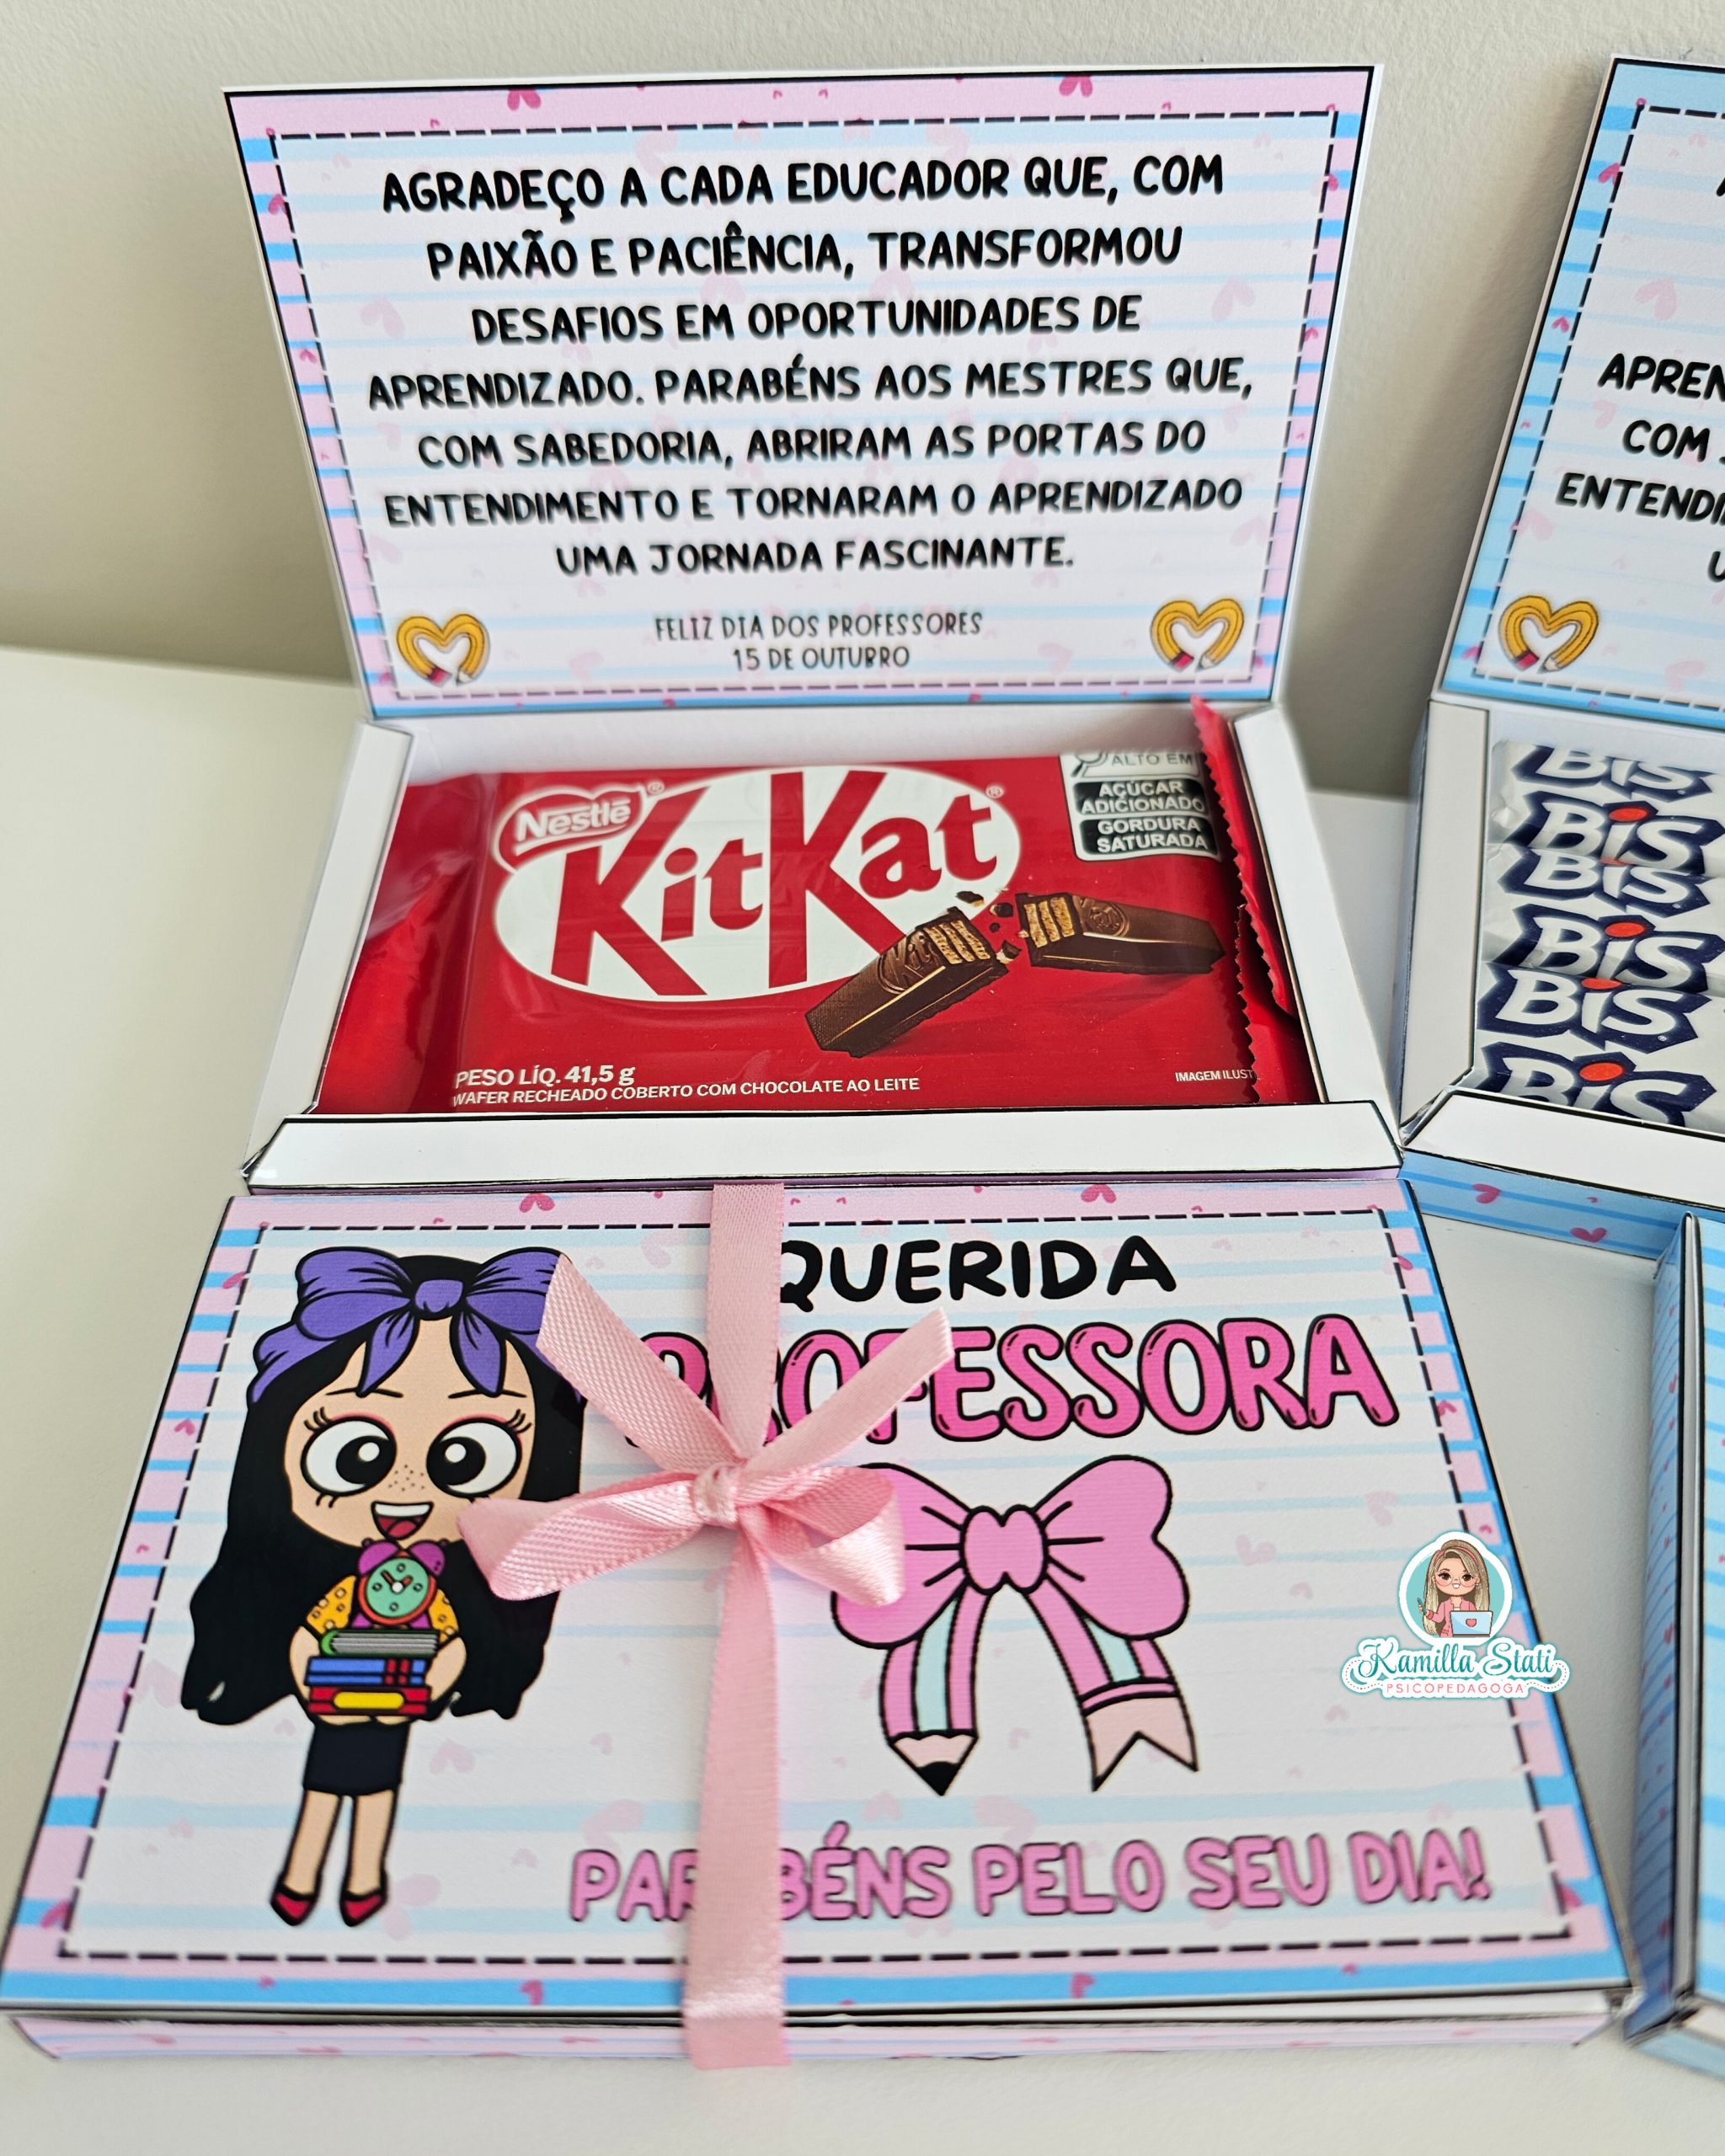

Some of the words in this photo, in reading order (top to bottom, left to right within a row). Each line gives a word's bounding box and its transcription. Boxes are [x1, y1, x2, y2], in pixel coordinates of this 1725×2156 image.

[382, 168, 605, 225] AGRADEÇO
[620, 167, 648, 208] A
[660, 163, 774, 206] CADA
[788, 158, 1010, 204] EDUCADOR
[1023, 156, 1119, 205] QUE,
[1133, 153, 1224, 196] COM
[426, 228, 579, 281] PAIXÃO
[590, 237, 617, 277] E
[628, 220, 854, 280] PACIÊNCIA,
[867, 225, 1183, 271] TRANSFORMOU
[471, 305, 664, 345] DESAFIOS
[676, 303, 735, 341] EM
[747, 296, 1080, 339] OPORTUNIDADES
[1092, 294, 1143, 332] DE
[369, 370, 644, 410] APRENDIZADO.
[654, 352, 861, 403] PARABÉNS
[874, 363, 952, 399] AOS
[965, 359, 1153, 398] MESTRES
[1166, 356, 1252, 400] QUE,
[418, 434, 504, 468] COM
[513, 430, 734, 469] SABEDORIA,
[746, 425, 912, 462] ABRIRAM
[925, 424, 975, 458] AS
[987, 420, 1145, 457] PORTAS
[1156, 419, 1206, 454] DO
[1622, 419, 1711, 463] COM
[383, 489, 680, 526] ENTENDIMENTO
[692, 488, 714, 520] E
[726, 483, 938, 519] TORNARAM
[951, 483, 975, 514] O
[988, 478, 1242, 514] APRENDIZADO
[1556, 472, 1725, 526] ENTENDI
[555, 545, 638, 576] UMA
[649, 541, 823, 574] JORNADA
[836, 536, 1074, 570] FASCINANTE.
[654, 616, 713, 641] FELIZ
[721, 614, 764, 639] DIA
[771, 614, 820, 638] DOS
[828, 611, 983, 637] PROFESSORES
[733, 647, 761, 671] 15
[767, 648, 793, 670] DE
[801, 645, 911, 670] OUTUBRO
[1111, 752, 1161, 767] ALTO
[1168, 752, 1194, 766] EM
[1081, 796, 1205, 814] ADICIONADO
[1098, 780, 1184, 800] AÇÚCAR
[1097, 817, 1201, 835] GORDURA
[1097, 833, 1209, 853] SATURADA
[452, 1091, 509, 1107] WAFER
[513, 1087, 607, 1103] RECHEADO
[611, 1084, 693, 1100] COBERTO
[697, 1082, 737, 1097] COM
[740, 1079, 843, 1095] CHOCOLATE
[846, 1079, 870, 1092] AO
[874, 1077, 921, 1091] LEITE
[455, 1068, 515, 1090] PESO
[519, 1065, 561, 1086] LÍQ.
[563, 1065, 614, 1086] 41,5
[618, 1066, 636, 1086] g
[1174, 1070, 1220, 1082] IMAGEM
[569, 1819, 953, 1922] PARBÉNS
[971, 1838, 1166, 1919] PELO
[1184, 1832, 1333, 1911] SEU
[1346, 1825, 1493, 1905] DIA!
